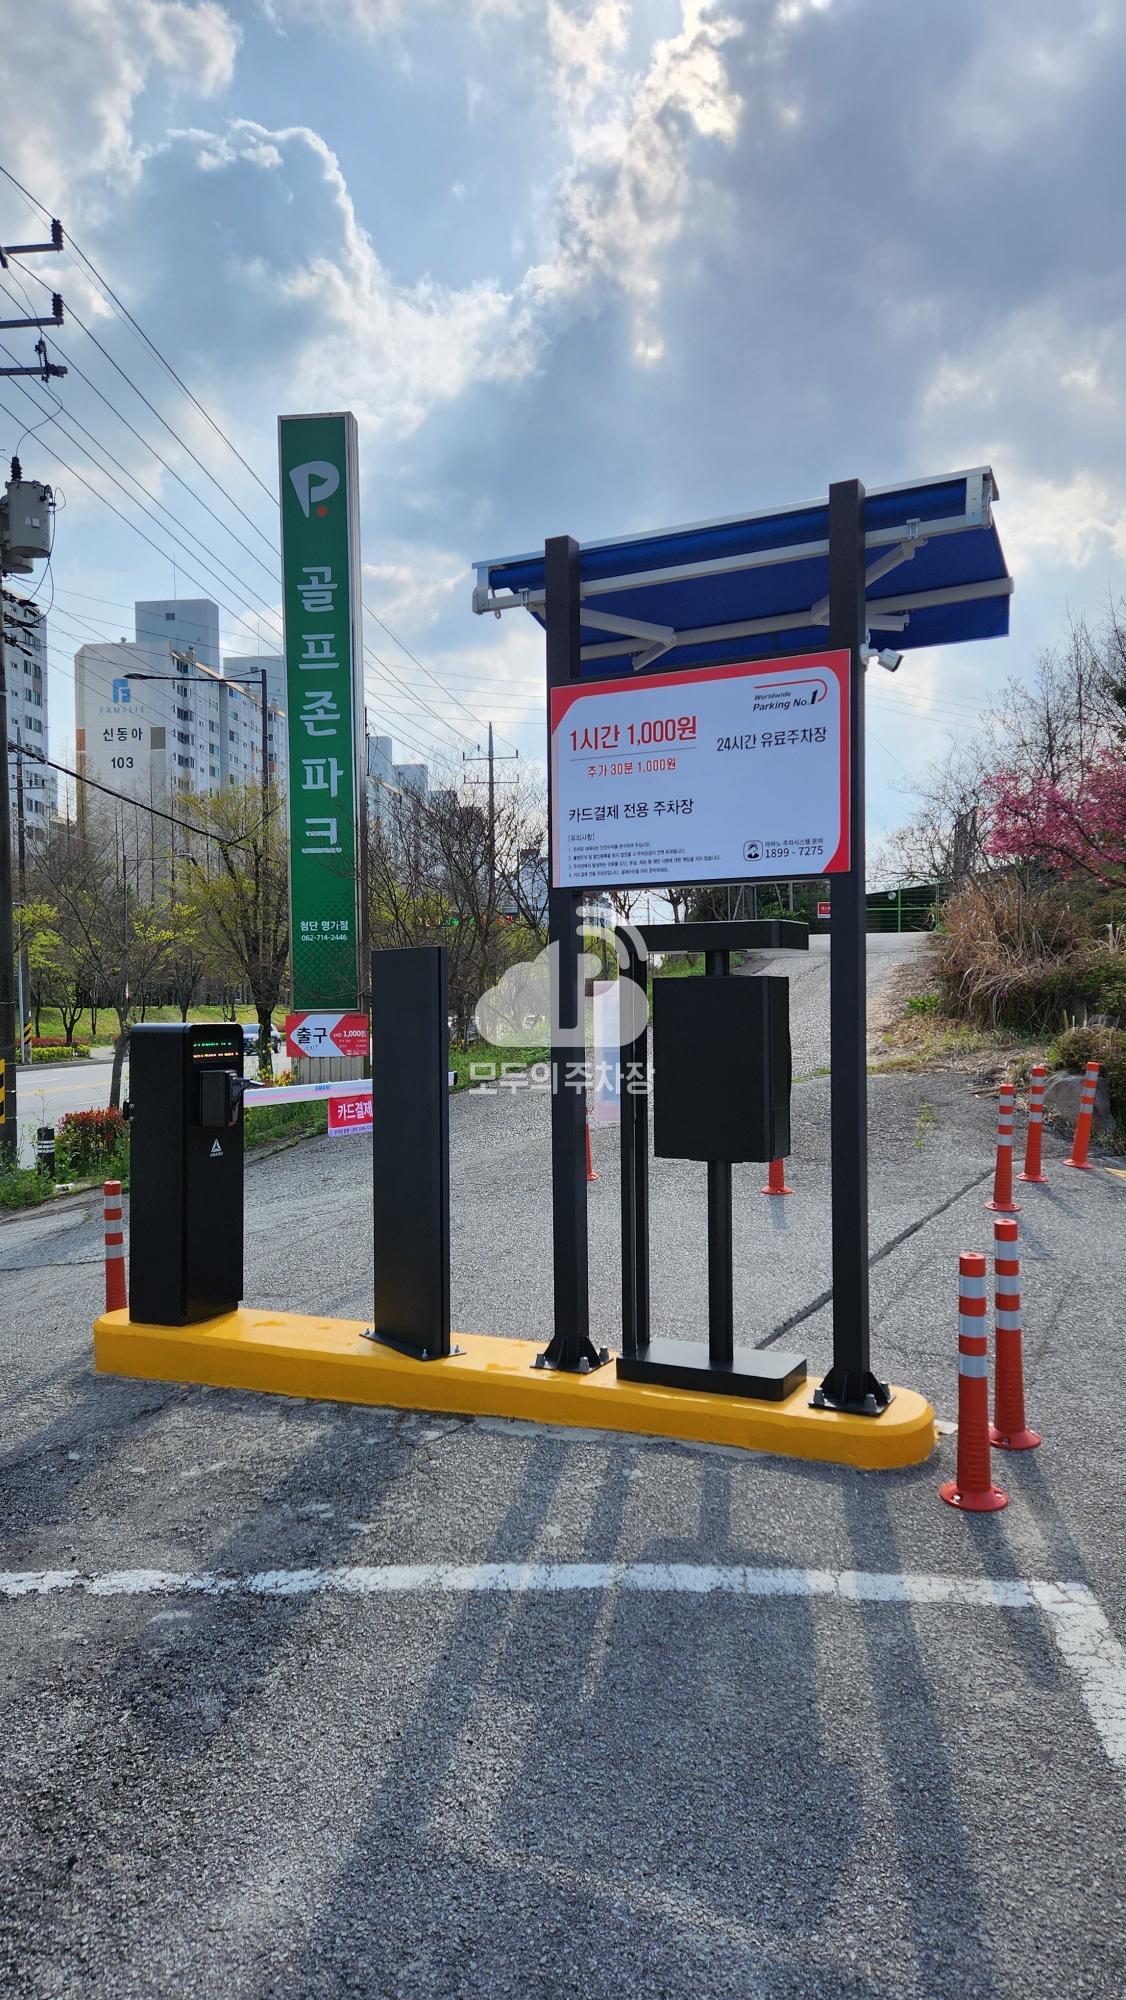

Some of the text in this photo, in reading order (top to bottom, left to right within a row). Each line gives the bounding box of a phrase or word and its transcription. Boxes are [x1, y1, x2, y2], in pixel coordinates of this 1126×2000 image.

[753, 689, 818, 712] Parking No.1
[754, 691, 792, 701] Worldwide
[100, 706, 145, 714] FAMILIE
[297, 566, 344, 854] 골프존파크
[103, 728, 143, 742] 신동아
[570, 715, 696, 751] 1시간 1,000원
[717, 726, 827, 752] 24시간 유료주차장
[111, 757, 134, 769] 103
[588, 757, 676, 778] 추가 30분 1,000원
[569, 798, 694, 822] 카드결제 전용 주차장
[300, 920, 318, 932] 첨단
[297, 1027, 328, 1044] 출구
